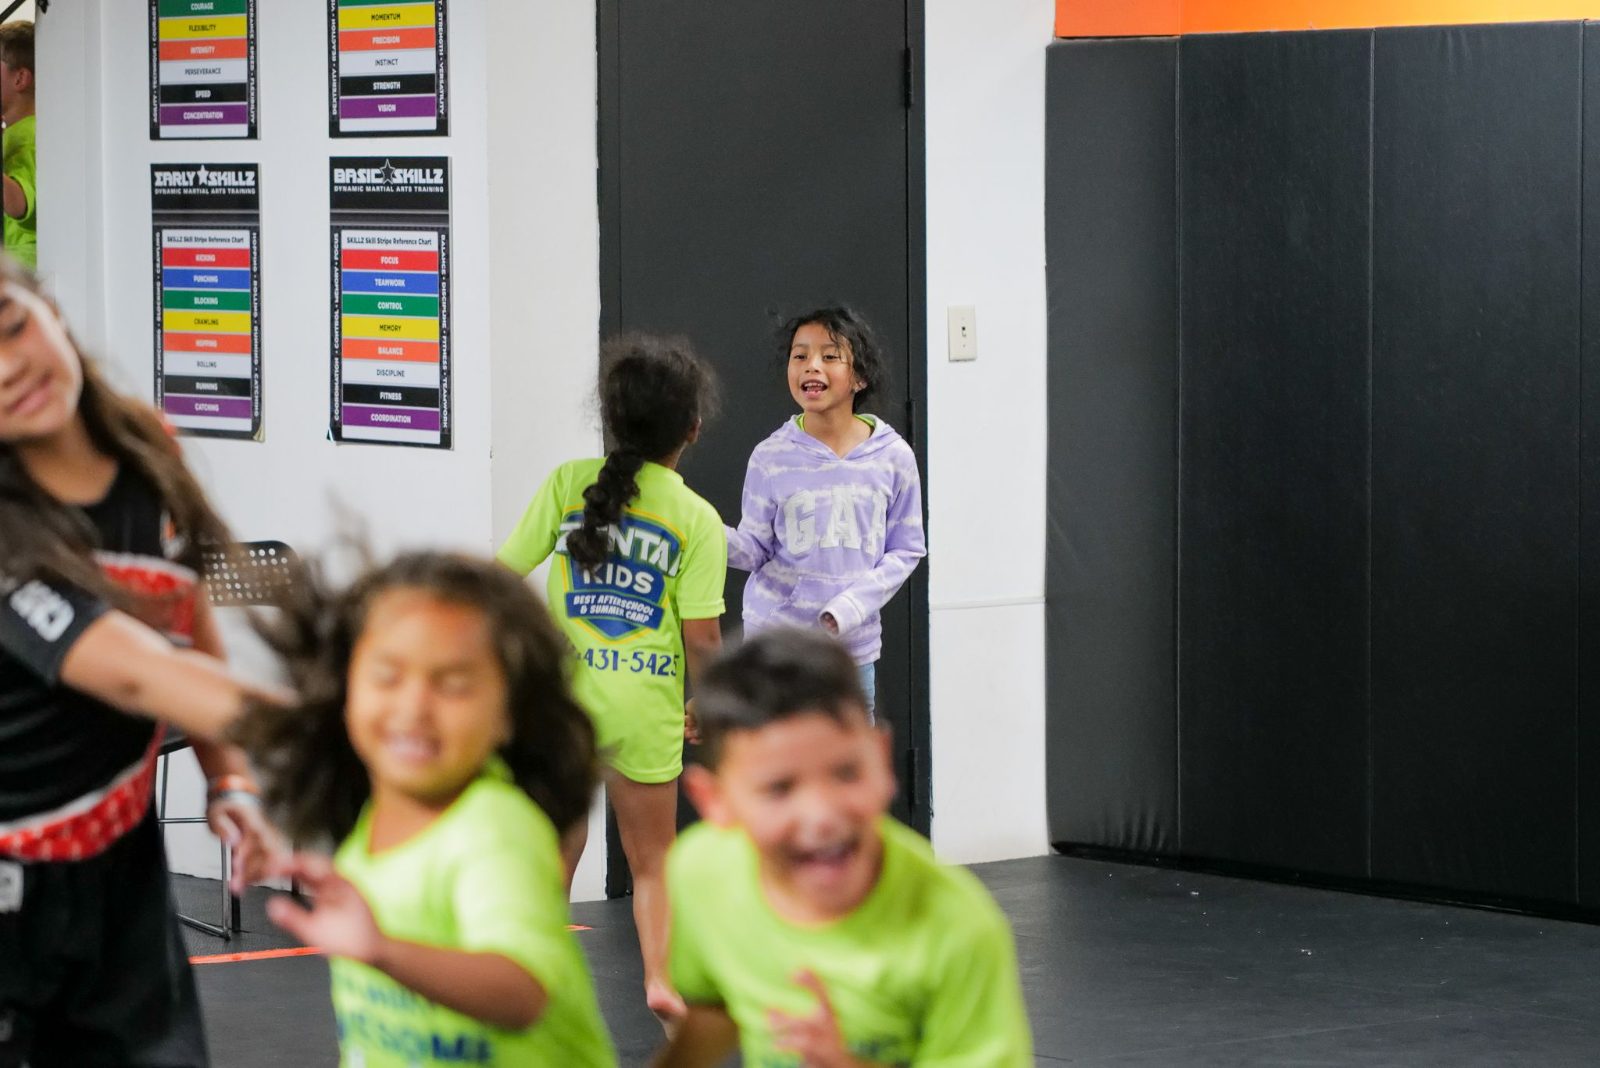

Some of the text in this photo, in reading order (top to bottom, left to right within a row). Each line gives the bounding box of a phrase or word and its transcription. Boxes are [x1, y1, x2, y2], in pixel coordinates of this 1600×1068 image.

[190, 2, 213, 10] COURAGE
[371, 13, 400, 21] MOMENTUM
[188, 24, 216, 32] FLEXIBILITY
[372, 36, 400, 44] PRECISION
[190, 46, 215, 54] INTENSITY
[373, 82, 400, 90] STRENGTH
[195, 90, 211, 98] SPEED
[378, 104, 396, 112] VISION
[183, 111, 223, 120] CONCENTRATION
[154, 171, 255, 186] EARLY SKILLZ
[334, 168, 444, 184] BASIC SKILLZ
[418, 238, 432, 246] Chart
[380, 256, 399, 264] FOCUS
[374, 278, 406, 287] TEAMWORK
[194, 296, 218, 305] BLOCKING
[377, 301, 403, 310] CONTROL
[194, 318, 219, 326] CRAWLING
[378, 346, 403, 355] BALANCE
[197, 360, 217, 368] ROLLING
[376, 369, 405, 377] DISCIPLINE
[196, 382, 218, 391] RUNNING
[380, 392, 402, 401] FITNESS
[194, 403, 220, 412] CATCHING
[371, 413, 412, 423] COORDINATION
[573, 595, 654, 616] BEST AFTERSCHOOL
[580, 604, 650, 624] & SUMMER CAMP
